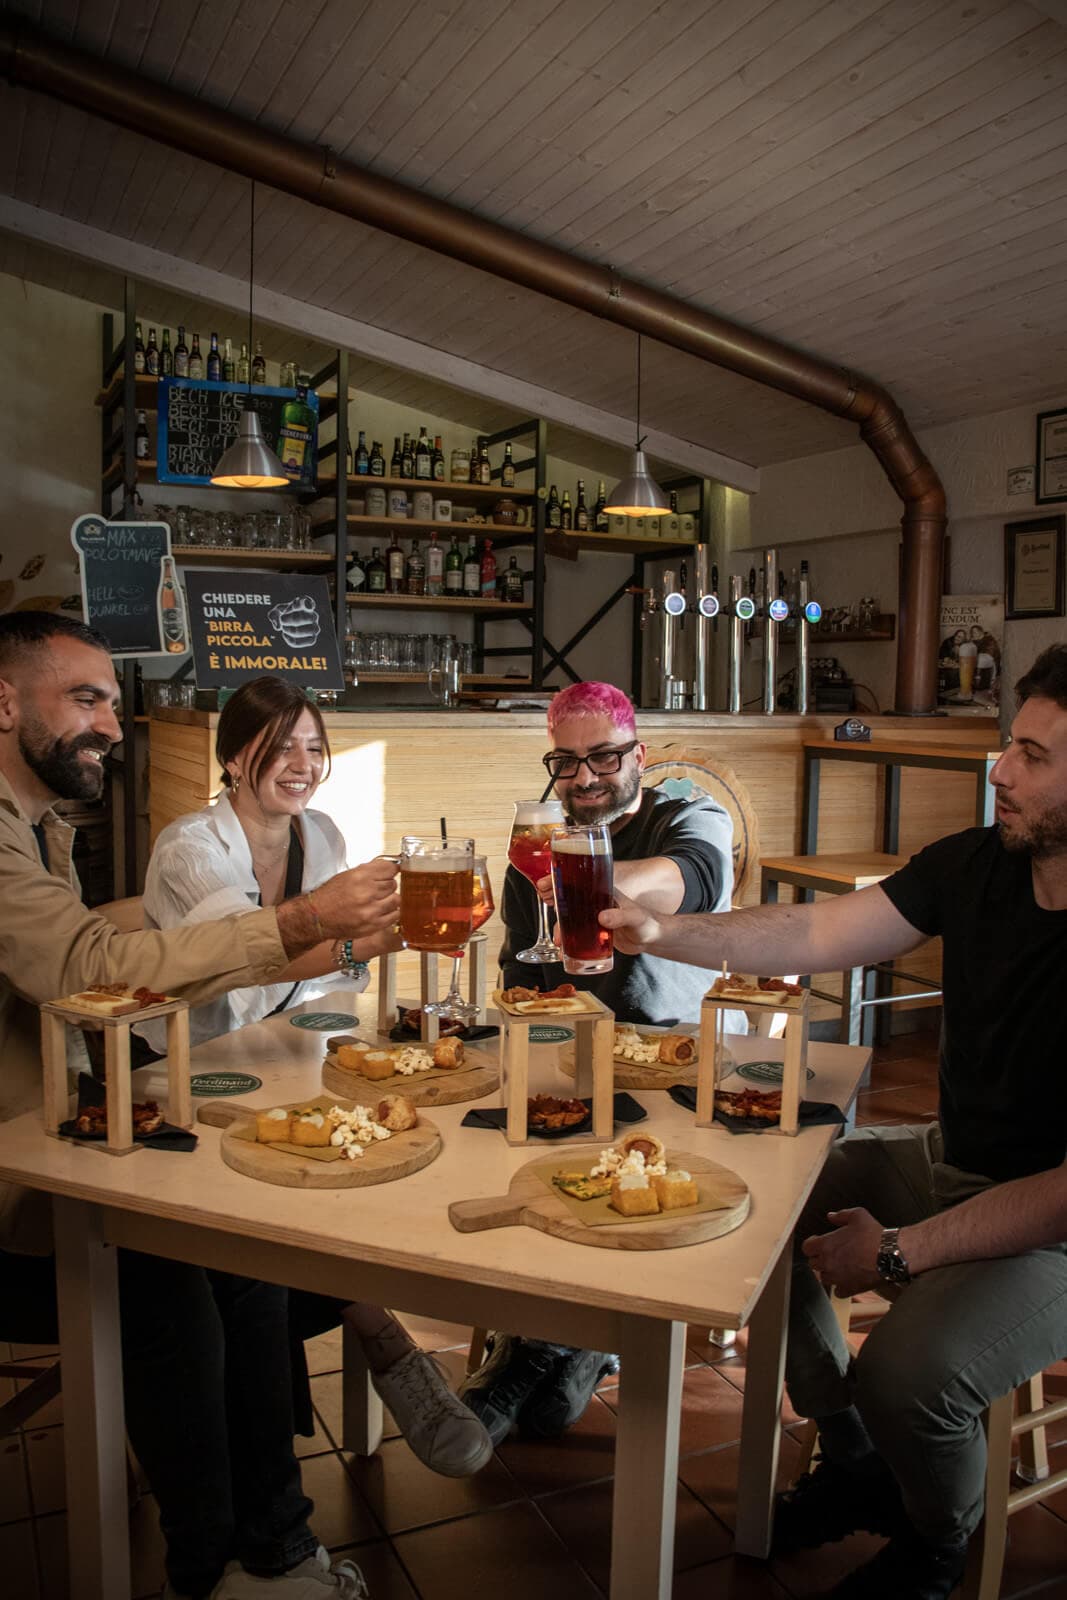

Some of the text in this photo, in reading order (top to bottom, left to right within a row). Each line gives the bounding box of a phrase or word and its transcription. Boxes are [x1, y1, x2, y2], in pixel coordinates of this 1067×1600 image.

[219, 391, 246, 408] ICE
[106, 528, 136, 547] MAX
[201, 593, 271, 606] CHIEDERE
[203, 607, 236, 618] UNA
[942, 615, 980, 624] ENDUM
[209, 652, 328, 671] È IMMORALE!
